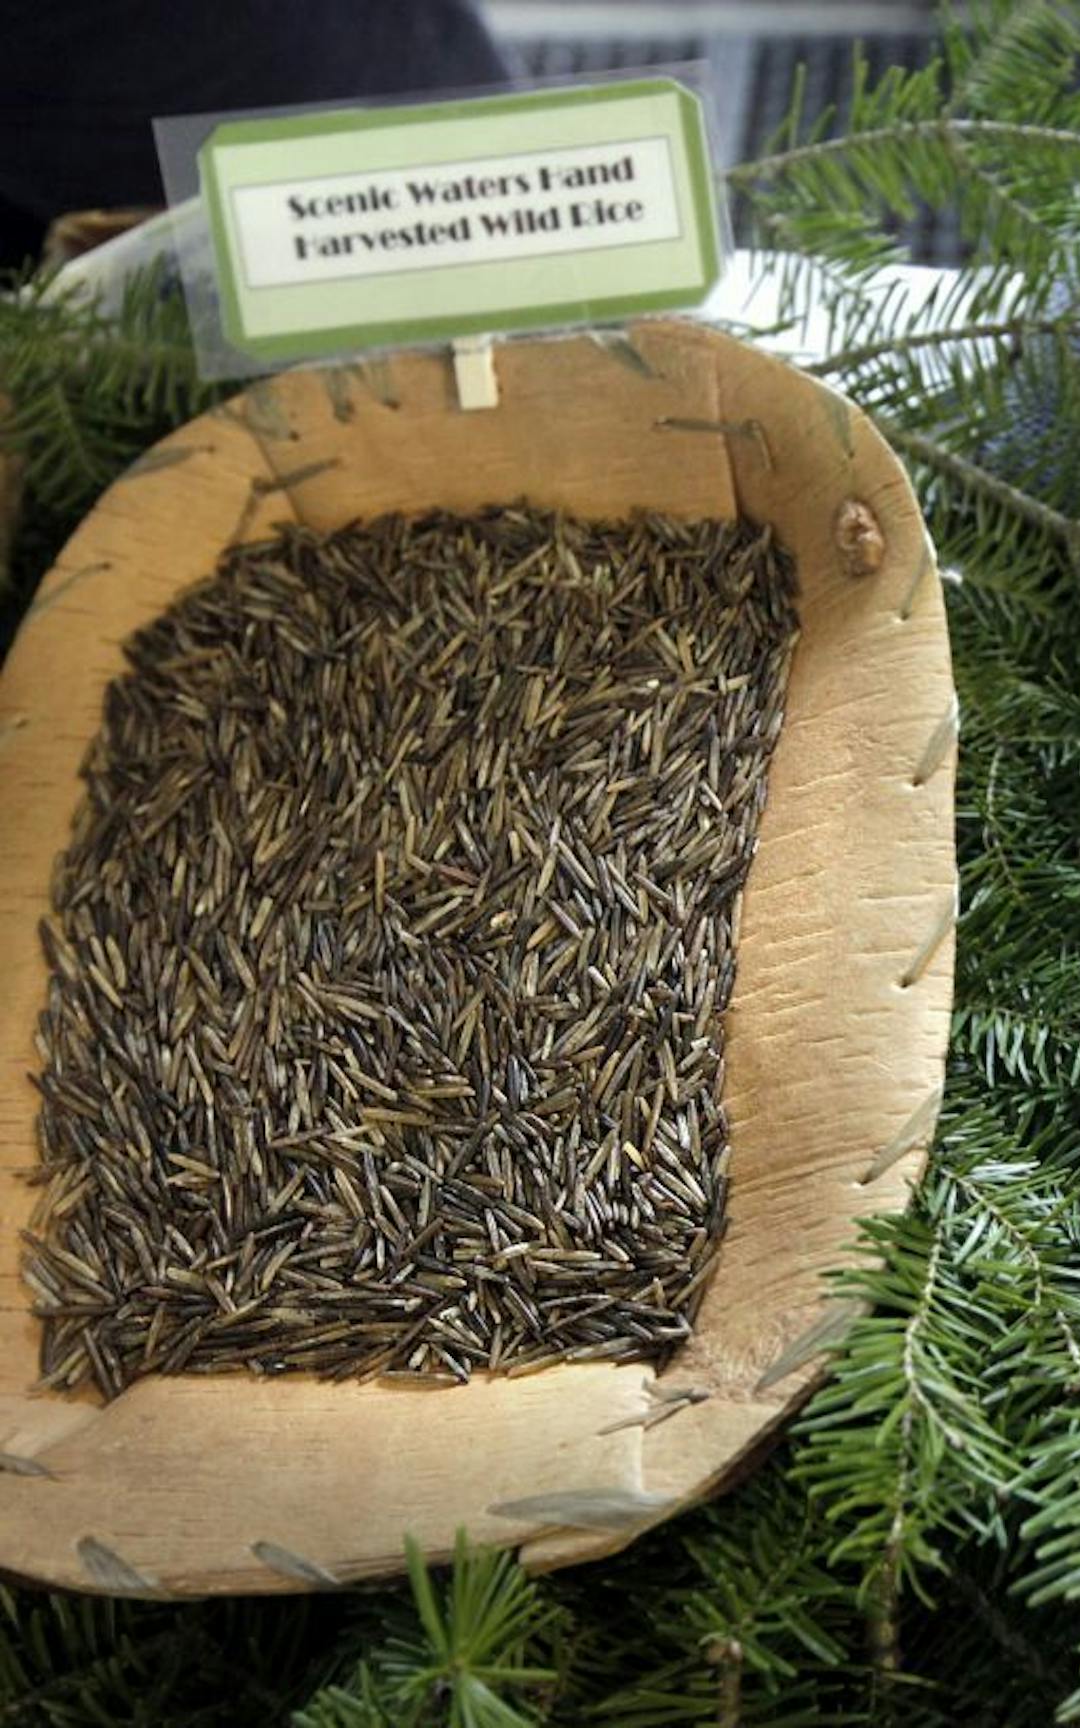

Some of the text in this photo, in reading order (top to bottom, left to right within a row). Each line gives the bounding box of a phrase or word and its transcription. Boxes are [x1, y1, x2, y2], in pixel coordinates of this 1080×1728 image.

[288, 156, 636, 221] Scenic Waters Hand
[294, 198, 644, 260] Harvested Wild Rice
